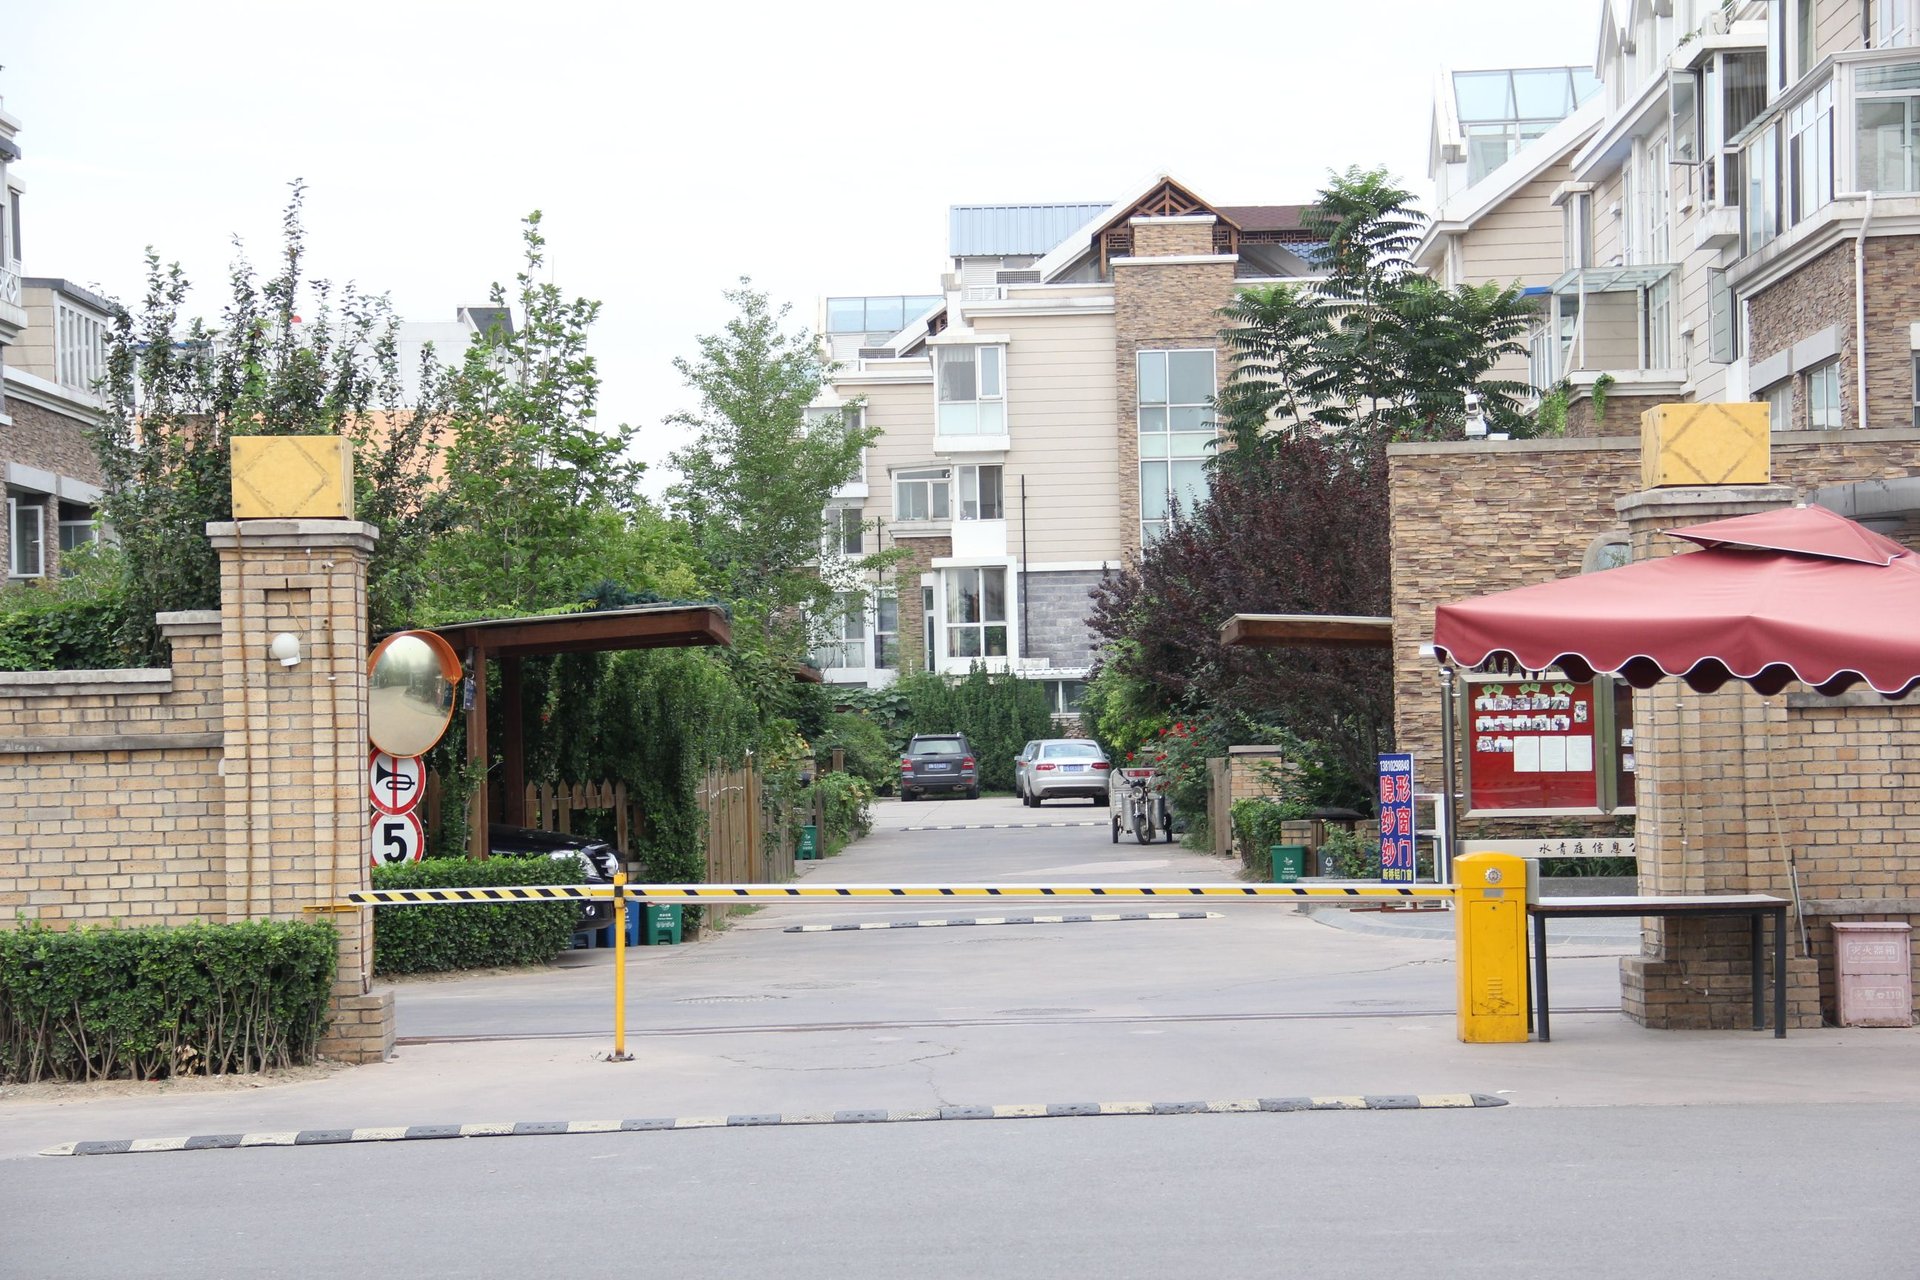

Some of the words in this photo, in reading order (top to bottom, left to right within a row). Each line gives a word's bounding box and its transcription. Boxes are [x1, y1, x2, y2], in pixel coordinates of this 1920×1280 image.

[1380, 774, 1411, 803] 隐形
[1381, 806, 1411, 835] 纱窗
[384, 823, 407, 864] 5
[1382, 838, 1412, 867] 纱门
